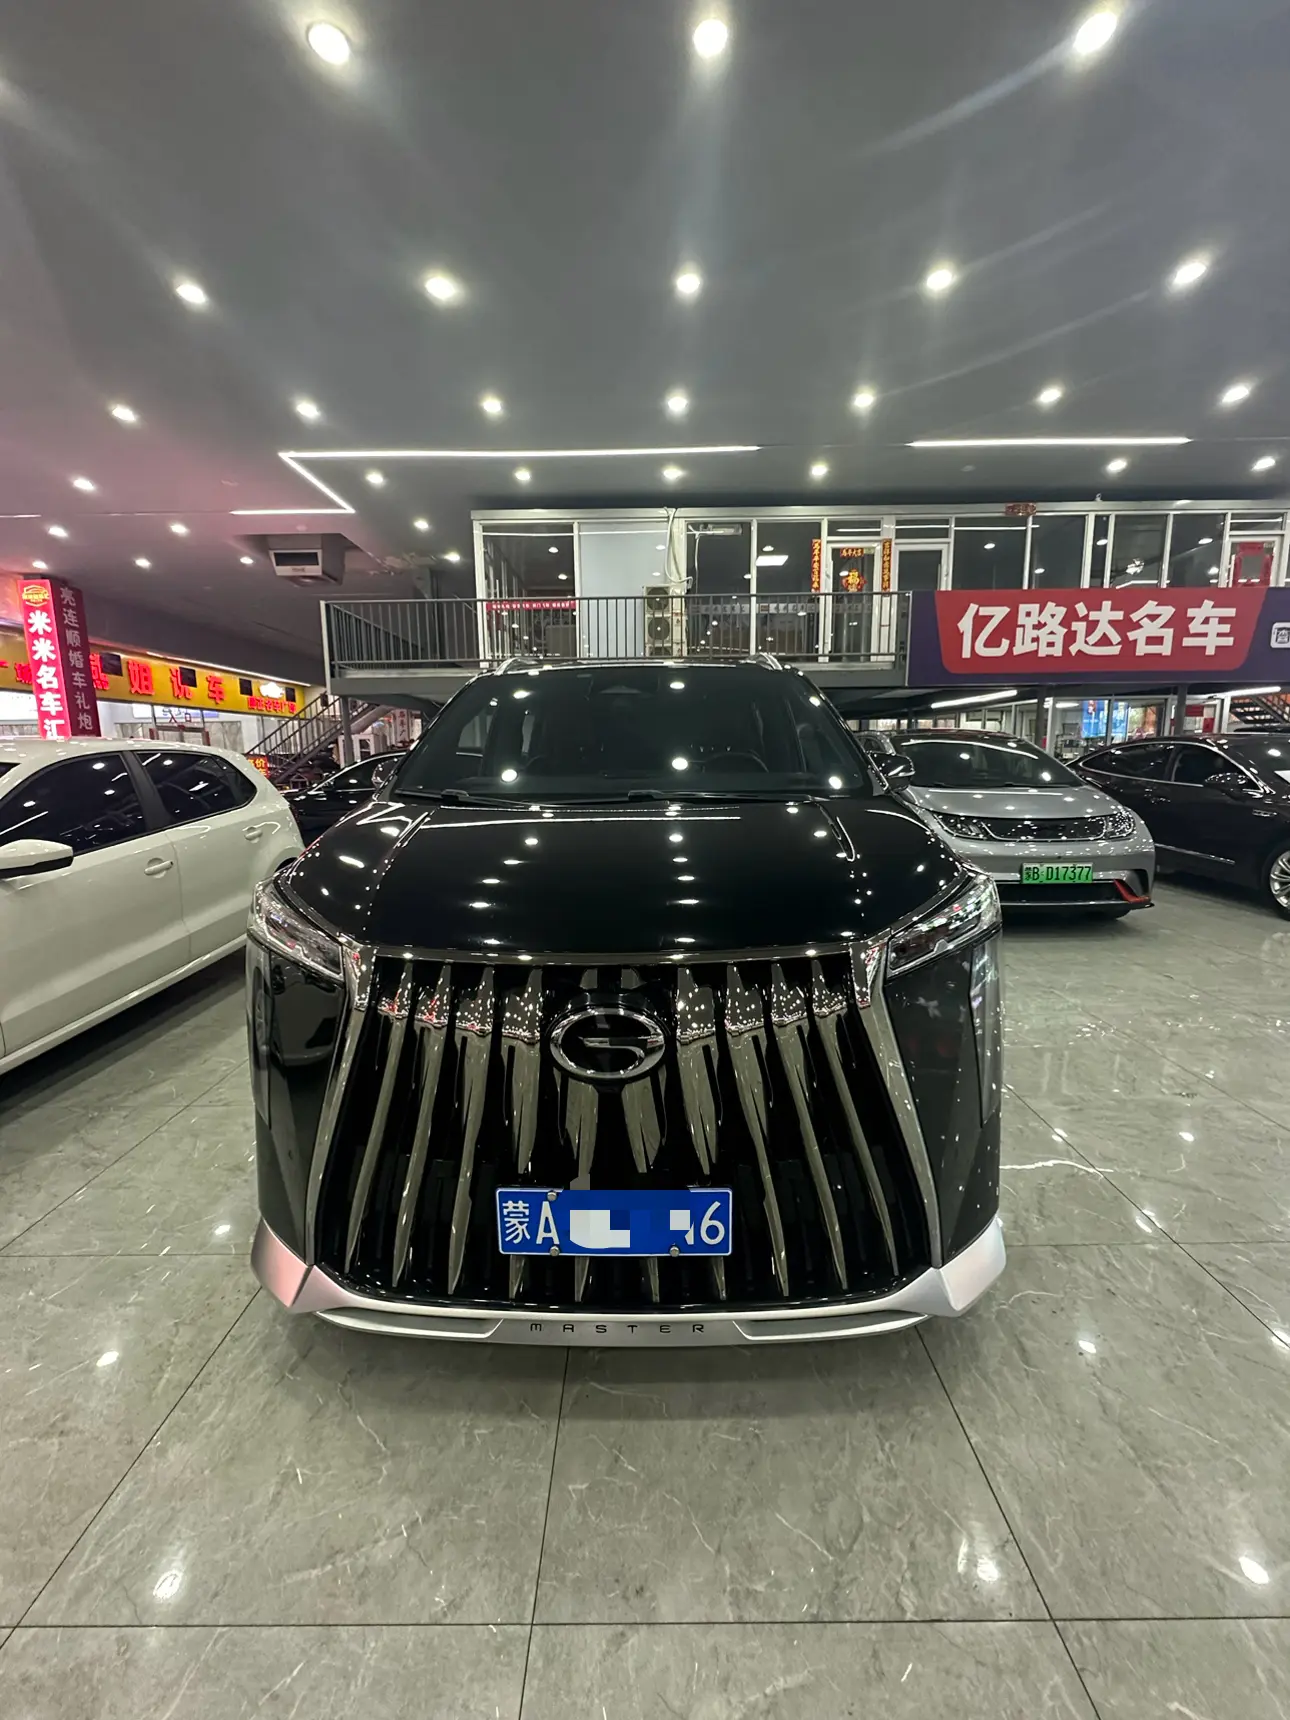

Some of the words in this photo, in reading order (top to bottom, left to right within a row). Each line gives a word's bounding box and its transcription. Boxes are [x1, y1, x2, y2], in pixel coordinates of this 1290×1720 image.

[956, 598, 1237, 660] 亿路达名车
[27, 609, 66, 740] 米米名车汇
[530, 1323, 705, 1334] MASTER
